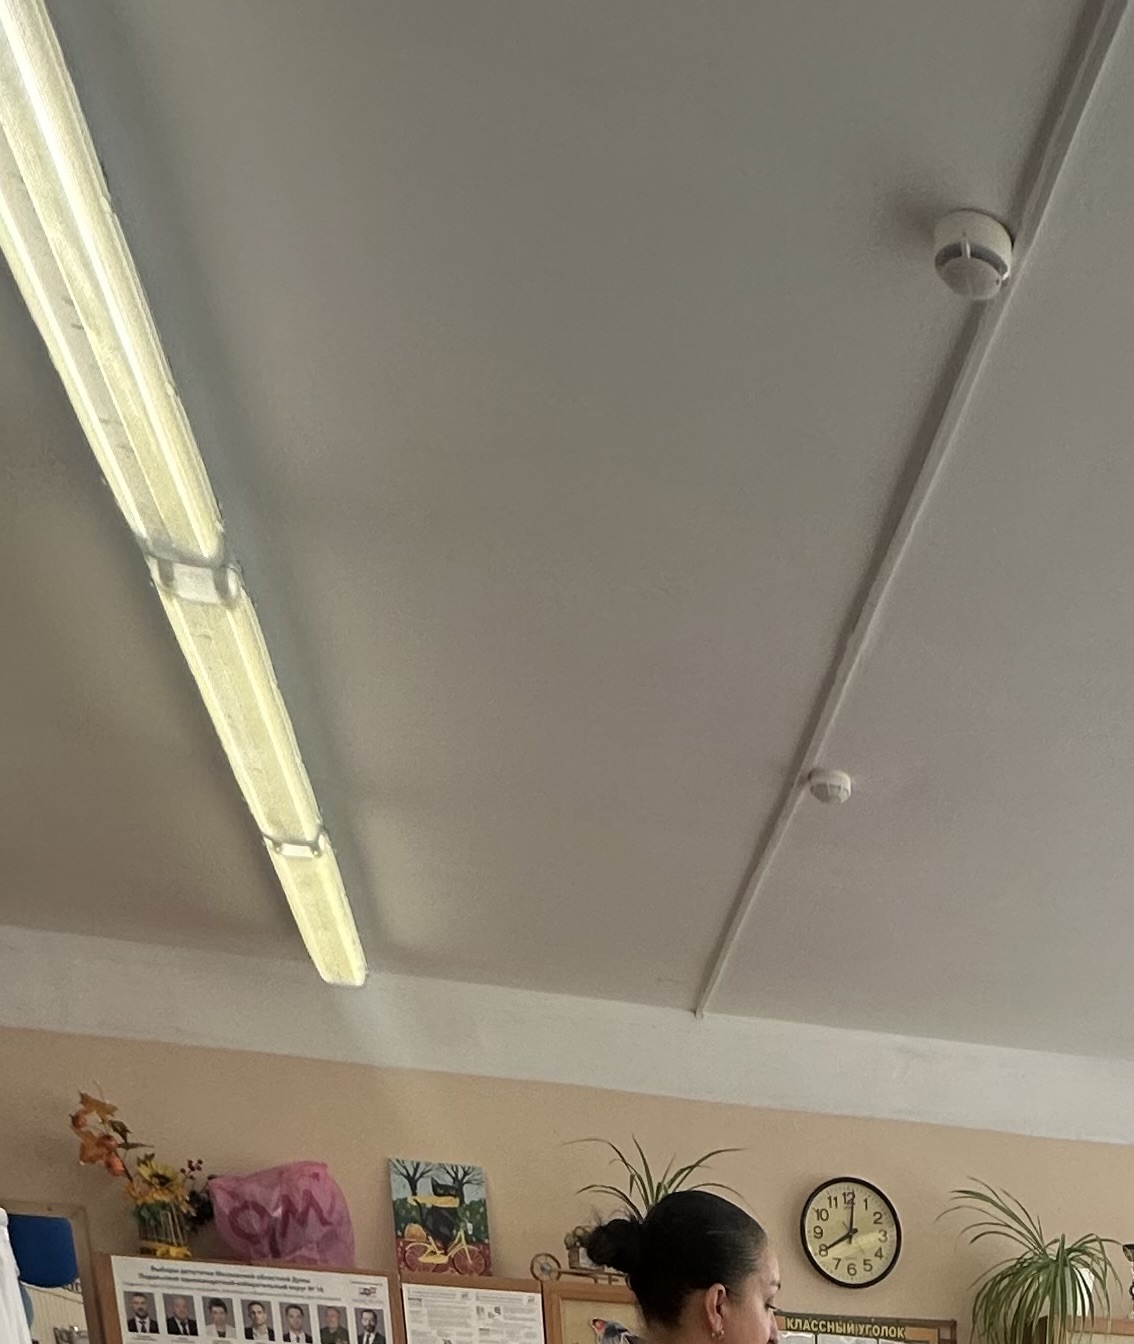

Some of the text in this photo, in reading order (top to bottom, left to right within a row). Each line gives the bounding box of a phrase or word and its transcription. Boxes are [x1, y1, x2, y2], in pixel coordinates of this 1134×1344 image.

[827, 1195, 838, 1209] 11
[842, 1191, 855, 1205] 12
[863, 1197, 869, 1211] 1
[816, 1208, 829, 1221] 10
[872, 1211, 883, 1225] 2
[813, 1225, 824, 1239] 9
[878, 1229, 888, 1243] 3
[819, 1243, 829, 1257] 8
[874, 1247, 884, 1260] 4
[832, 1257, 842, 1270] 7
[846, 1263, 857, 1276] 6
[863, 1259, 873, 1272] 5
[786, 1317, 906, 1339] КЛАССНЫЙ УГОЛОК
